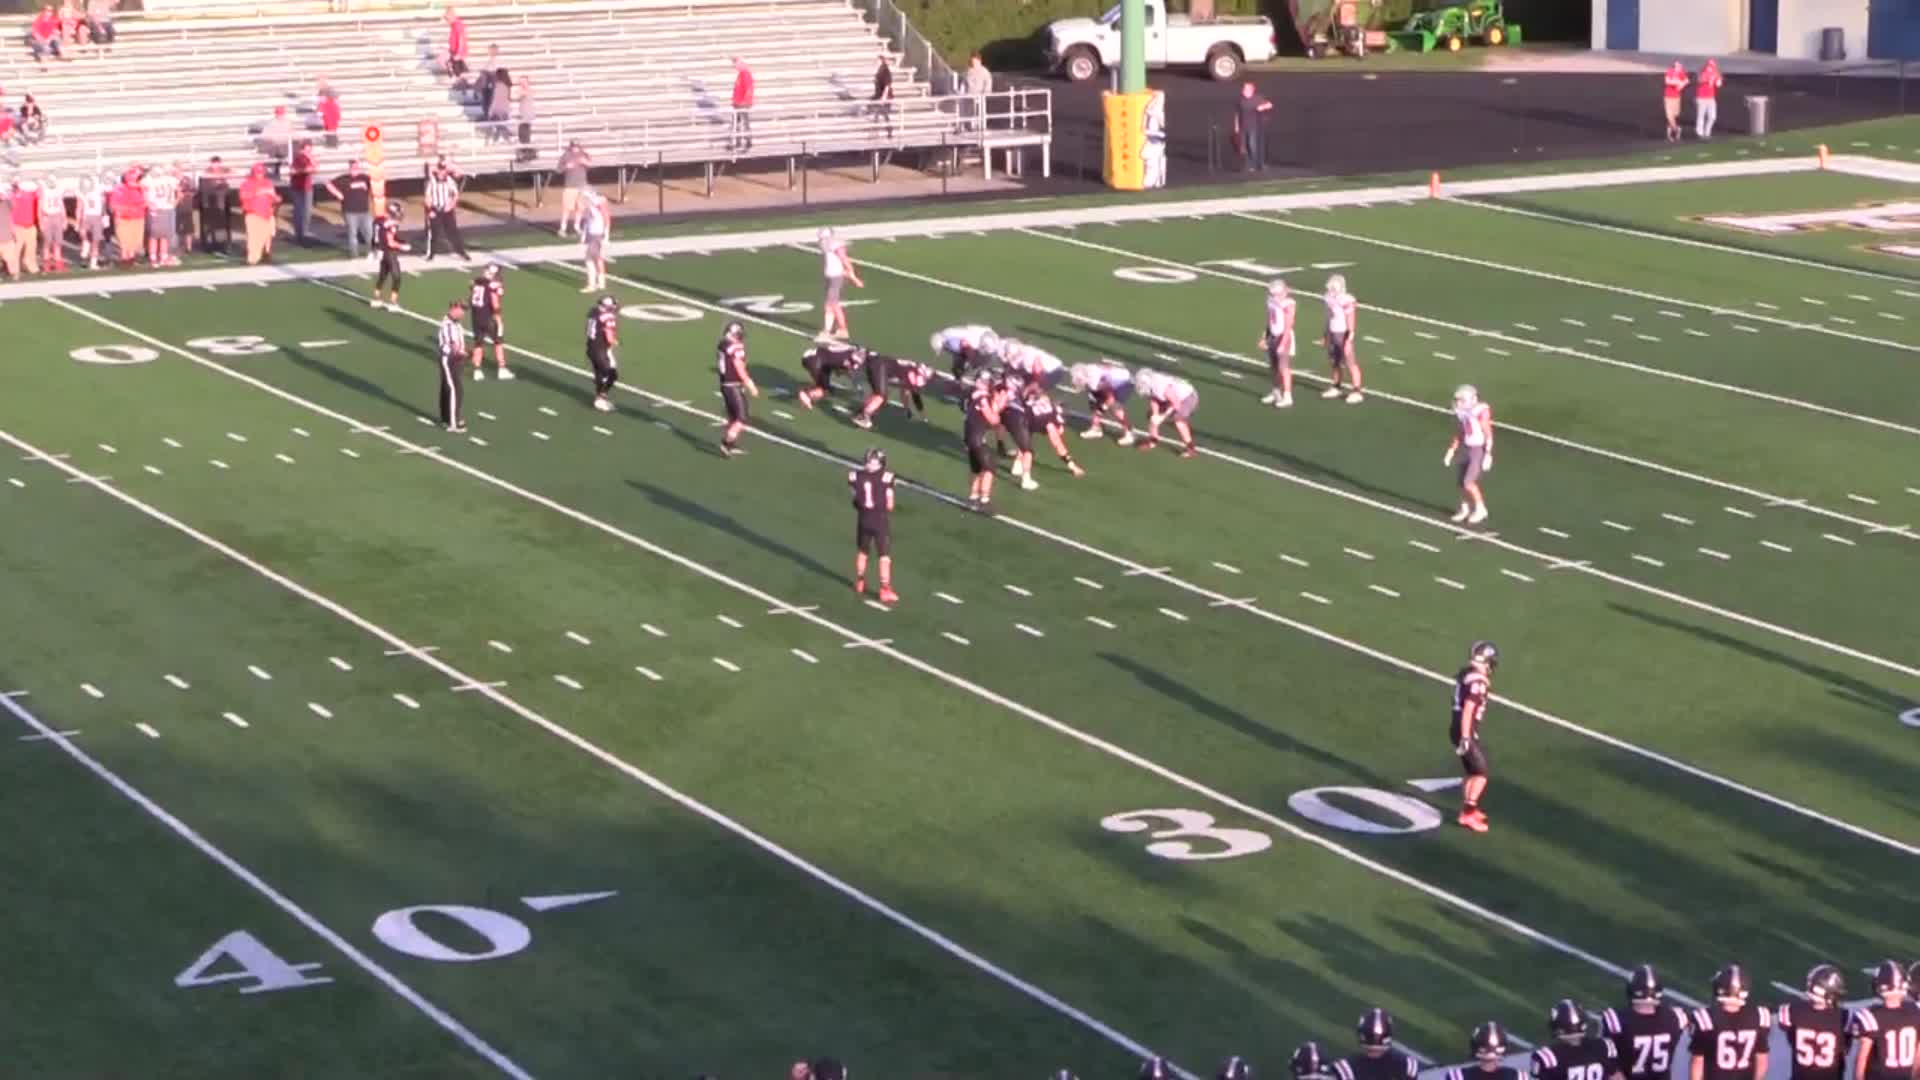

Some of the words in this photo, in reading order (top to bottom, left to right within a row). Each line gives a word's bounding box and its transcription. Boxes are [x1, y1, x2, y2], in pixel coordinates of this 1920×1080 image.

[863, 481, 875, 509] 1
[1100, 786, 1442, 860] 30
[174, 904, 532, 994] 40
[1631, 1033, 1672, 1074] 75
[1716, 1029, 1757, 1070] 67
[1795, 1028, 1837, 1067] 53
[1884, 1026, 1917, 1068] 10
